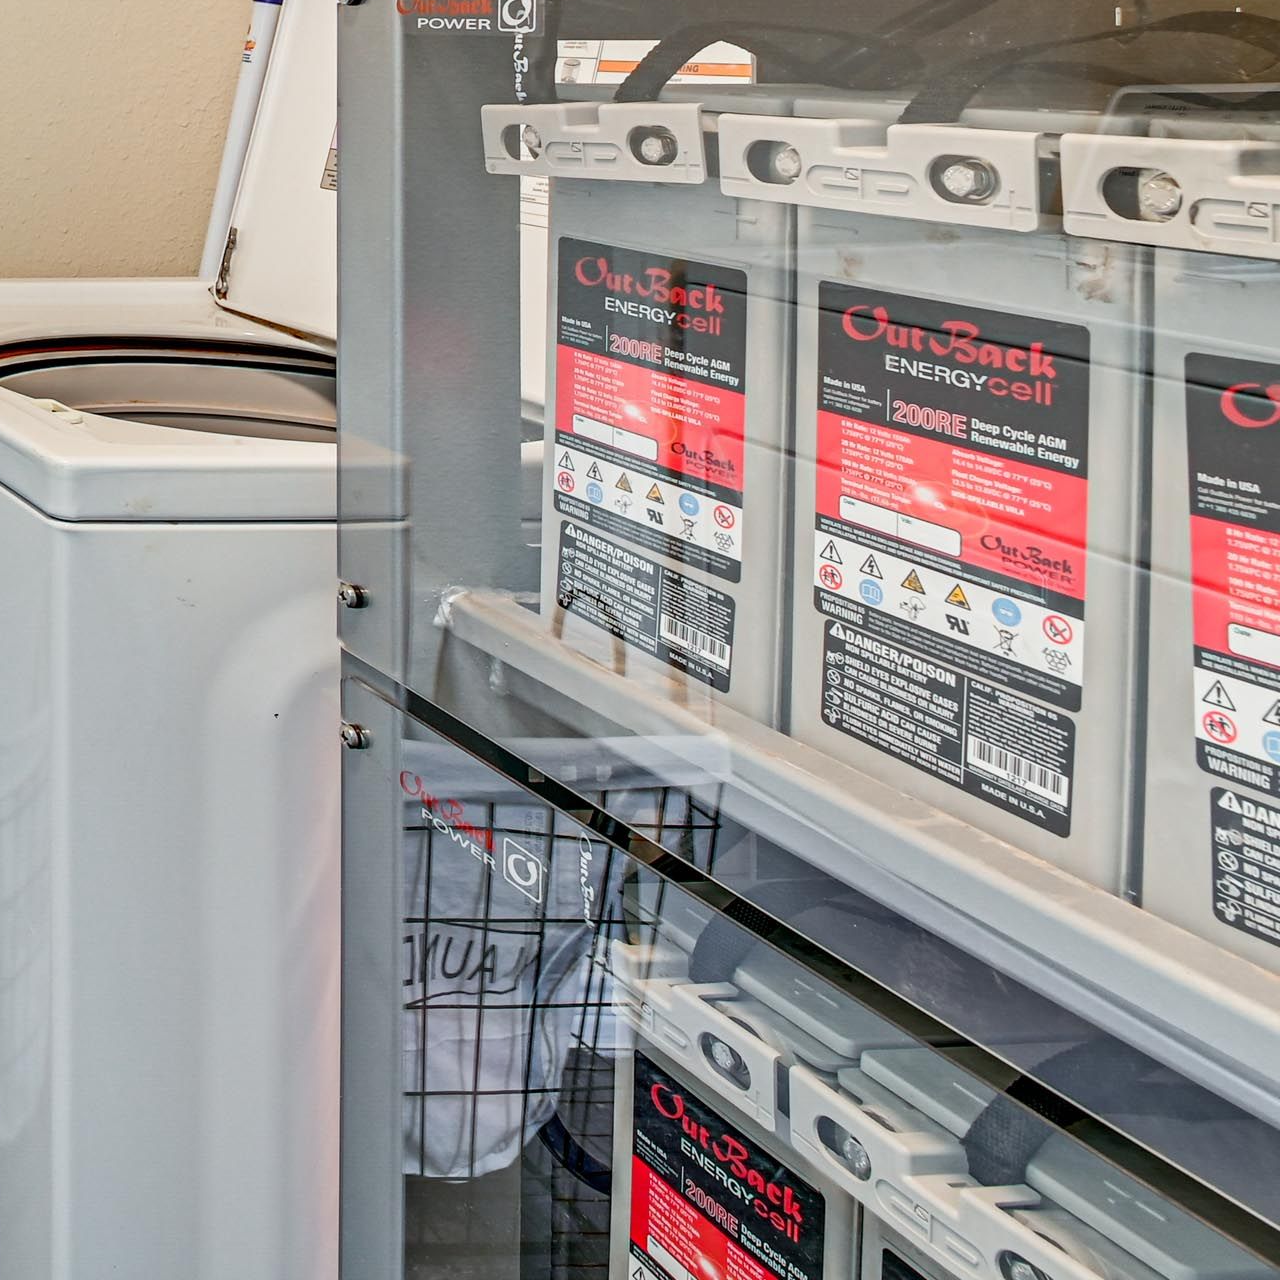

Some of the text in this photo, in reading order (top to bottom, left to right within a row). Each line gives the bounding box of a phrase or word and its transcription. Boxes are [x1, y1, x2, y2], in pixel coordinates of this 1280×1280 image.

[417, 17, 491, 31] POWER
[575, 256, 725, 314] OutBack
[561, 315, 592, 329] Made USA
[604, 296, 721, 337] ENERGYcell
[609, 334, 731, 372] 200RE Deep Cycle AGM
[841, 304, 1057, 380] OutBack
[664, 357, 740, 387] Renewable Energy
[823, 375, 866, 393] Made in USA
[885, 354, 1053, 406] ENERGYcell
[892, 400, 1067, 451] 200RE Deep Cycle AGM
[970, 431, 1080, 470] Renewable Energy
[1197, 472, 1261, 494] Made in USA
[559, 500, 590, 521] WARNING
[576, 530, 654, 575] DANGER/POISON
[980, 534, 1073, 575] OutBack
[1001, 556, 1073, 585] POWER
[819, 591, 858, 612] PROPOSITION
[820, 601, 864, 625] WARNING
[669, 650, 696, 670] MADE IN
[845, 628, 957, 688] DANGER/POISON
[845, 642, 928, 685] NON SPILLABLE BATTERY
[843, 654, 959, 713] SHIELD EYES EXPLOSIVE GASES
[844, 665, 955, 720] CAN CAUSE BLINDNESS OR INJURY
[970, 680, 1047, 717] CALIF. PROPOSITION
[842, 702, 938, 753] BLINDNESS OR SEVERE BURNS
[843, 677, 958, 738] NO SPARKS, FLAMES, OR SMOKING
[843, 691, 942, 745] SULFURIC ACID CAN CAUSE
[998, 698, 1035, 719] WARNING
[842, 713, 961, 775] FLUSH EYES IMMEDIATELY WITH WATER
[1204, 744, 1260, 772] PROPOSITION
[1006, 772, 1027, 787] 1217
[1207, 755, 1271, 790] WARNING
[981, 782, 1019, 808] MADE IN
[421, 807, 496, 871] POWER
[637, 1128, 668, 1161] Made USA
[650, 1082, 803, 1223] OutBack
[680, 1136, 801, 1244] ENERGYcell
[685, 1178, 809, 1280] 200RE Deep Cycle AGM
[740, 1235, 786, 1279] Renewable
